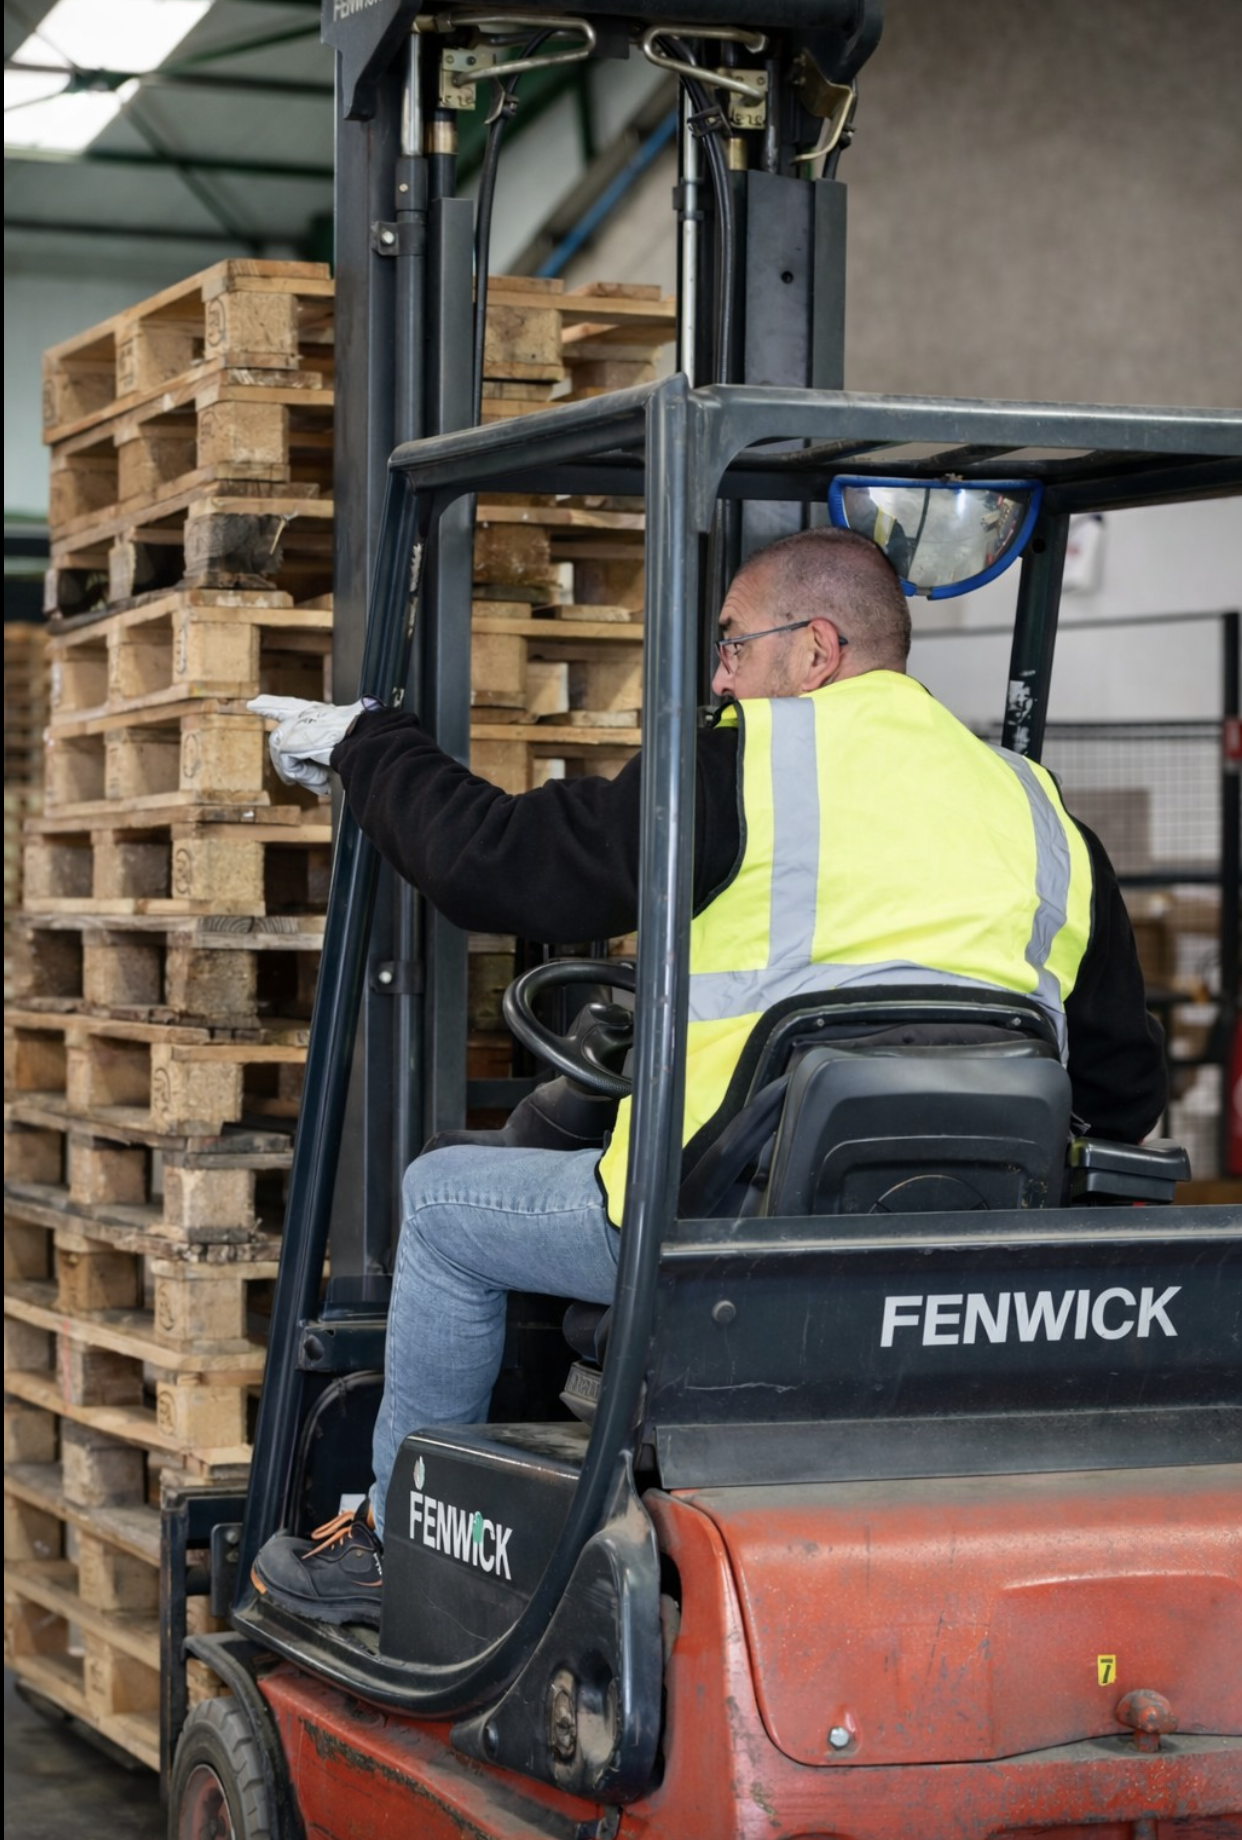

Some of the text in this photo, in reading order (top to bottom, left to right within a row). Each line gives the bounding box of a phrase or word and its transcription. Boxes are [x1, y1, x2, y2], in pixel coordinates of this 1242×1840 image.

[880, 1286, 1182, 1347] FENWICK
[410, 1491, 513, 1580] FENWICK
[1100, 1659, 1113, 1684] 7
